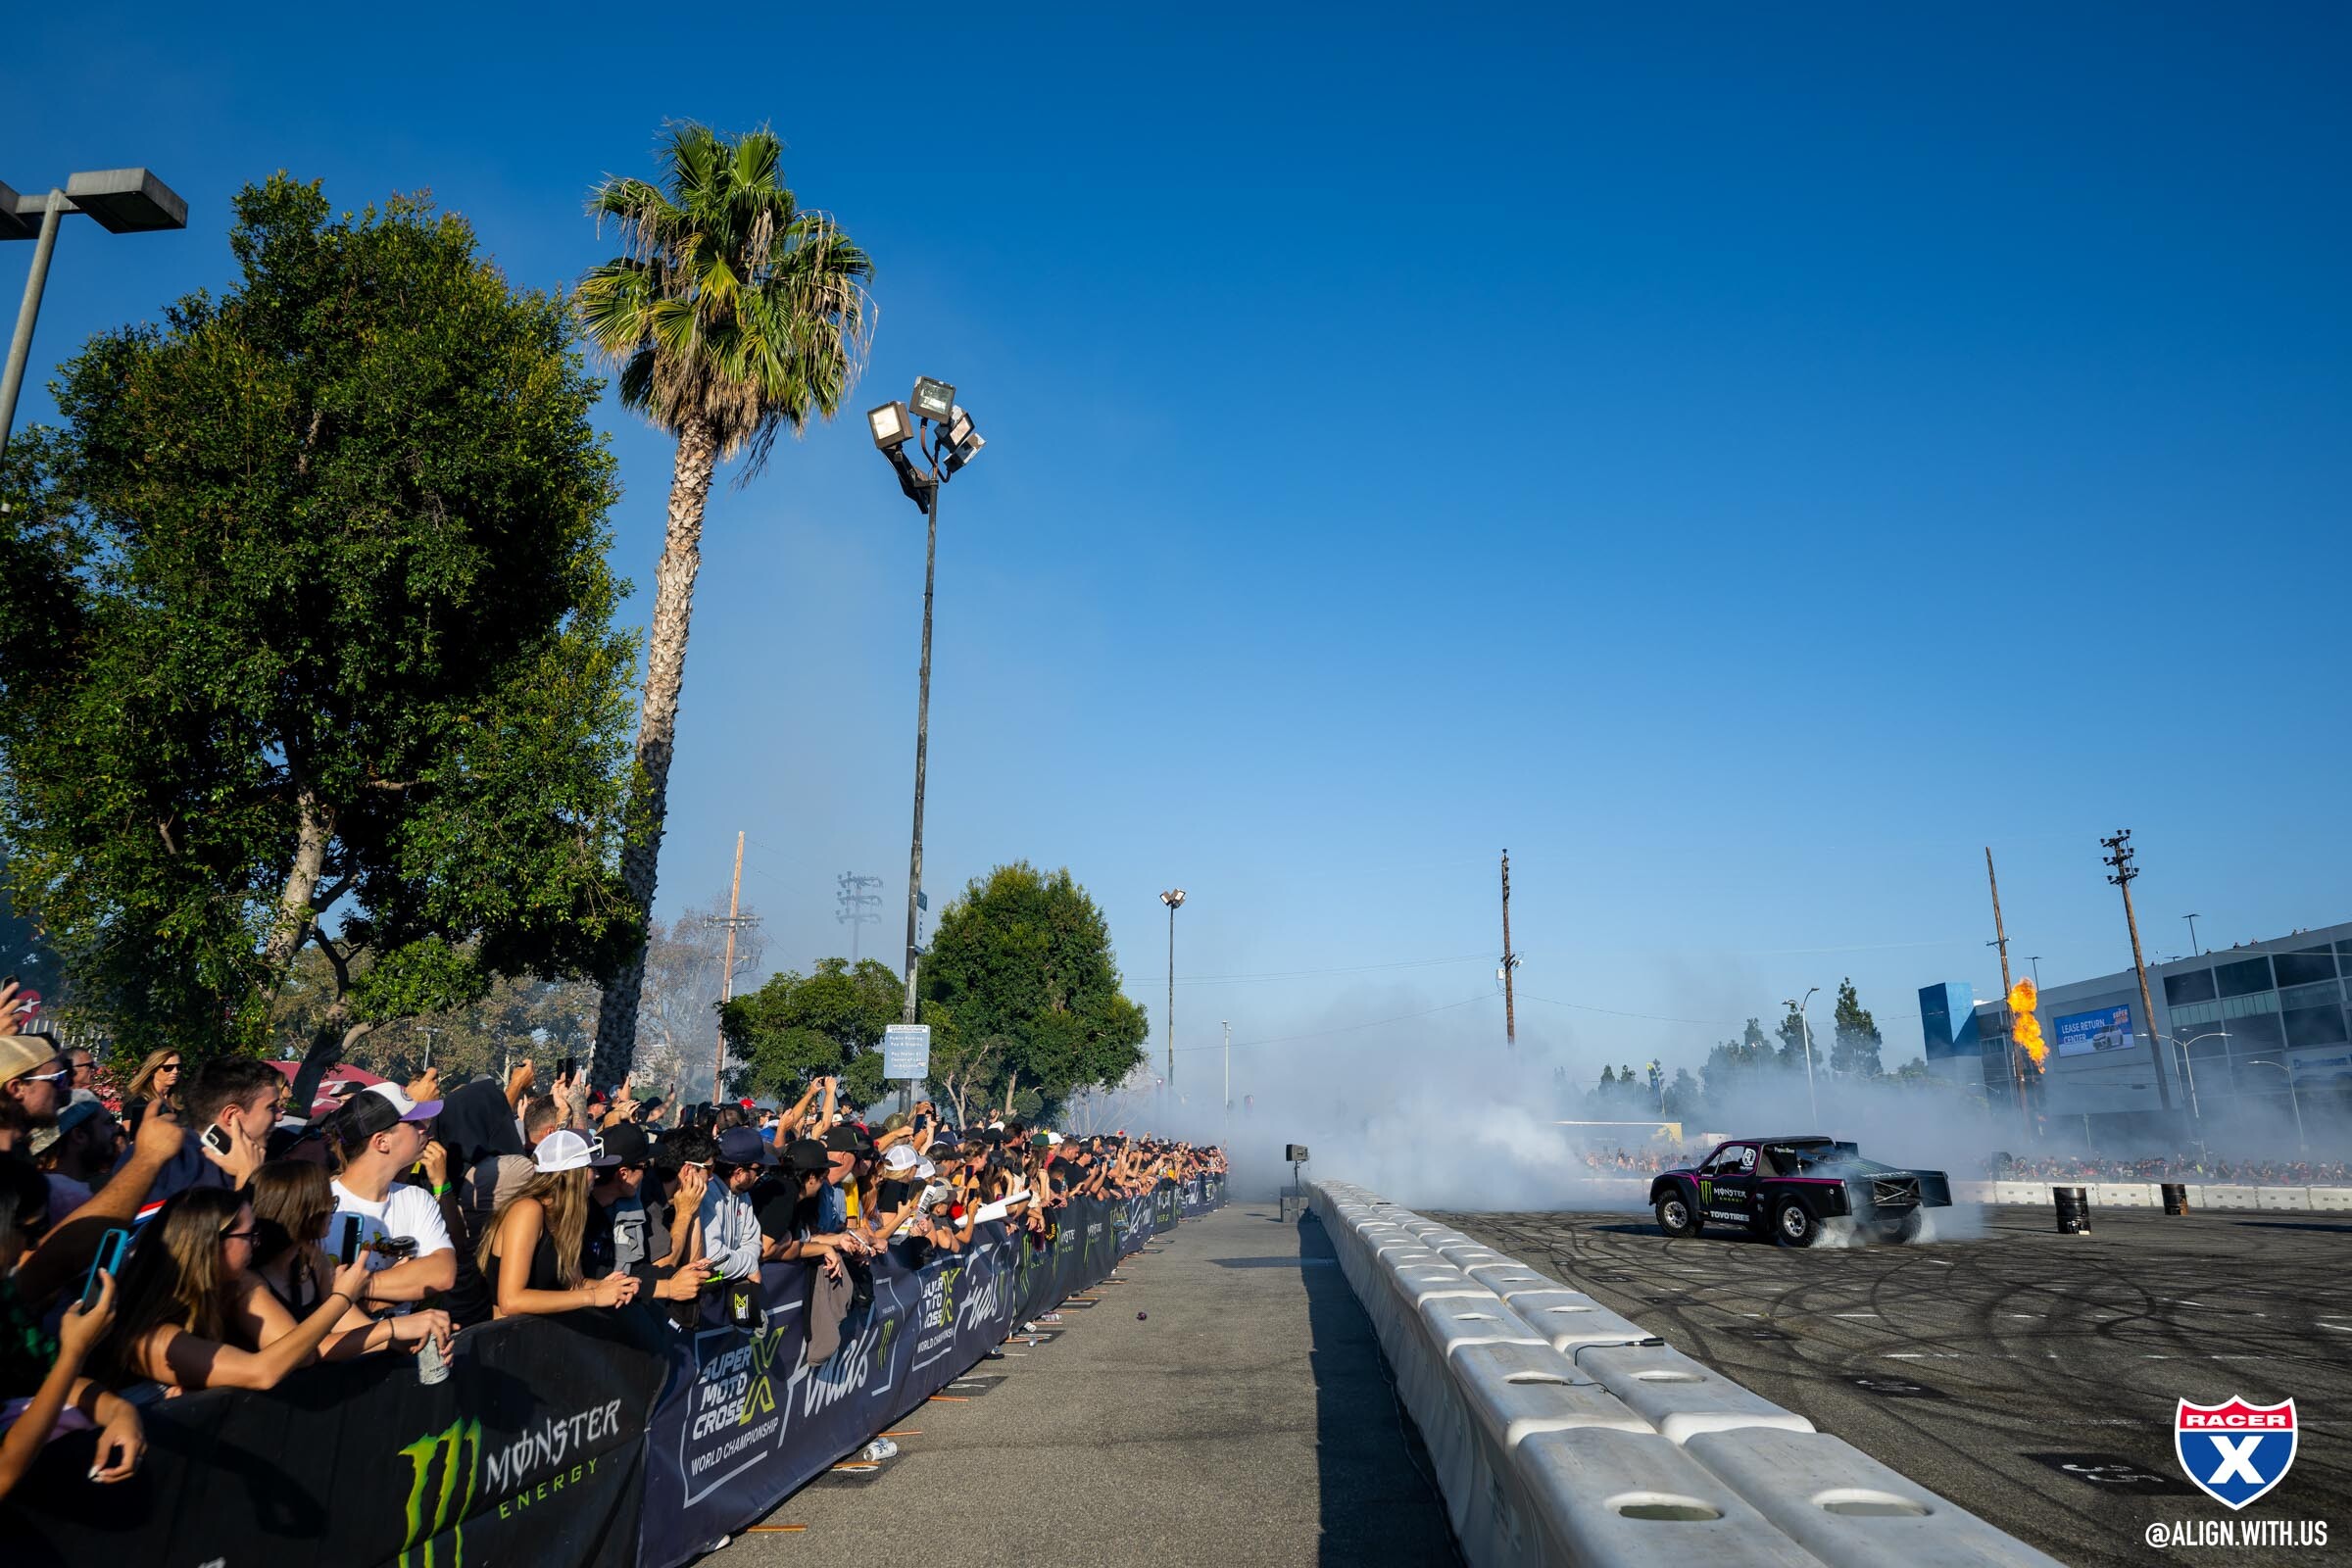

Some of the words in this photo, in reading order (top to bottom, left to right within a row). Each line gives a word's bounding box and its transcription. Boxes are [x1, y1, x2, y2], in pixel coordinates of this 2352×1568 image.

[2061, 1022, 2081, 1034] LEASE
[2081, 1019, 2105, 1032] RETURN
[2063, 1033, 2086, 1044] CENTER
[1713, 1187, 1746, 1199] MONSTER
[1710, 1210, 1729, 1219] TOYO
[1729, 1212, 1750, 1222] TIRES
[698, 1345, 754, 1385] SUPER
[700, 1371, 749, 1411] MOTO
[692, 1396, 746, 1441] CROSS
[485, 1397, 622, 1495] MONSTER
[691, 1446, 722, 1477] WORLD
[723, 1416, 780, 1460] CHAMPIONSHIP
[498, 1457, 599, 1520] ENERGY
